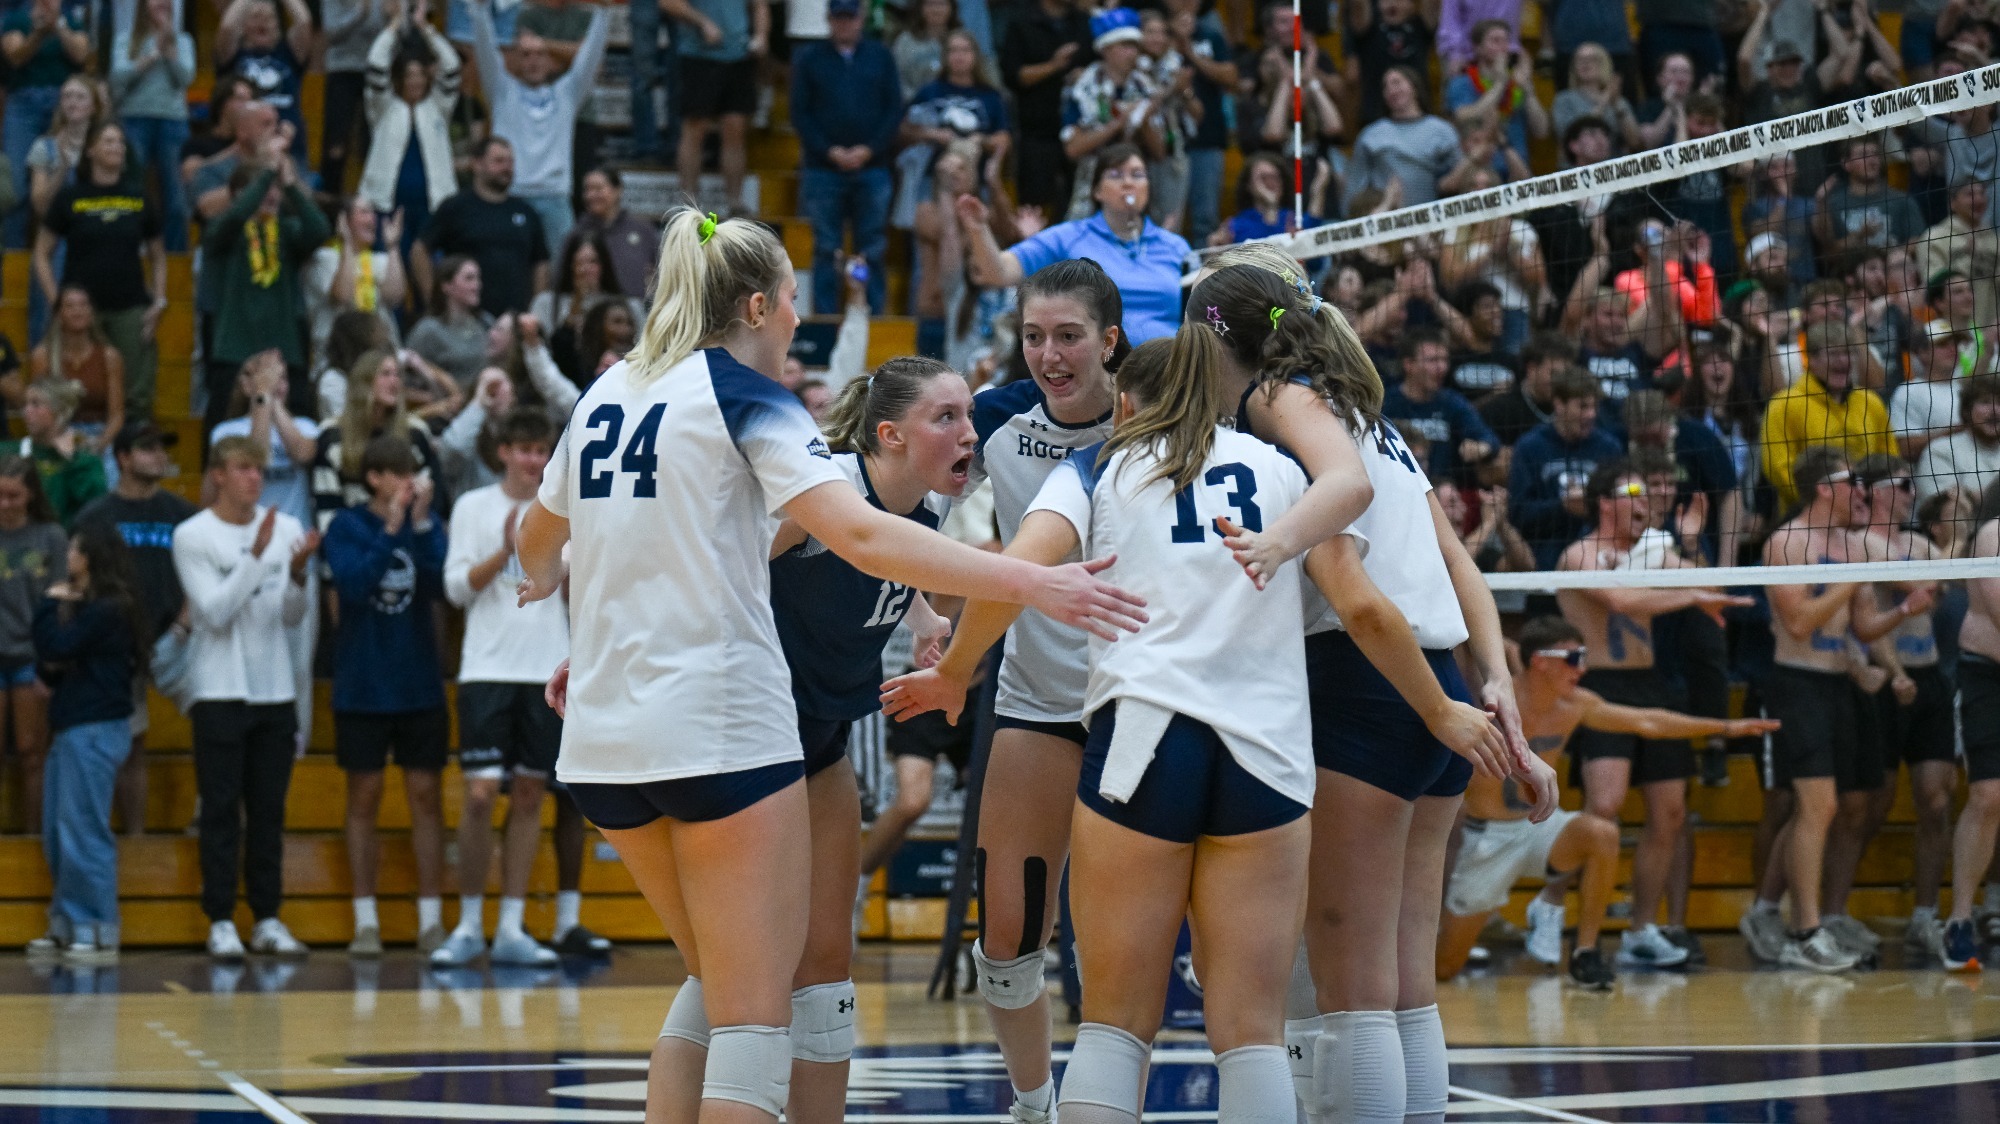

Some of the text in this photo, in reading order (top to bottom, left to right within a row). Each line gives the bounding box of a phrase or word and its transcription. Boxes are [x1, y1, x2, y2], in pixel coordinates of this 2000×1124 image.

[1871, 79, 1959, 118] SOUTH DAKOTA MINES
[1770, 106, 1850, 142] SOUTH DAKOTA MINES
[1679, 130, 1751, 165] SOUTH DAKOTA MINES
[1593, 153, 1662, 184] SOUTH DAKOTA MINES
[580, 402, 668, 499] 24
[1167, 462, 1263, 543] 13
[862, 580, 909, 628] 12
